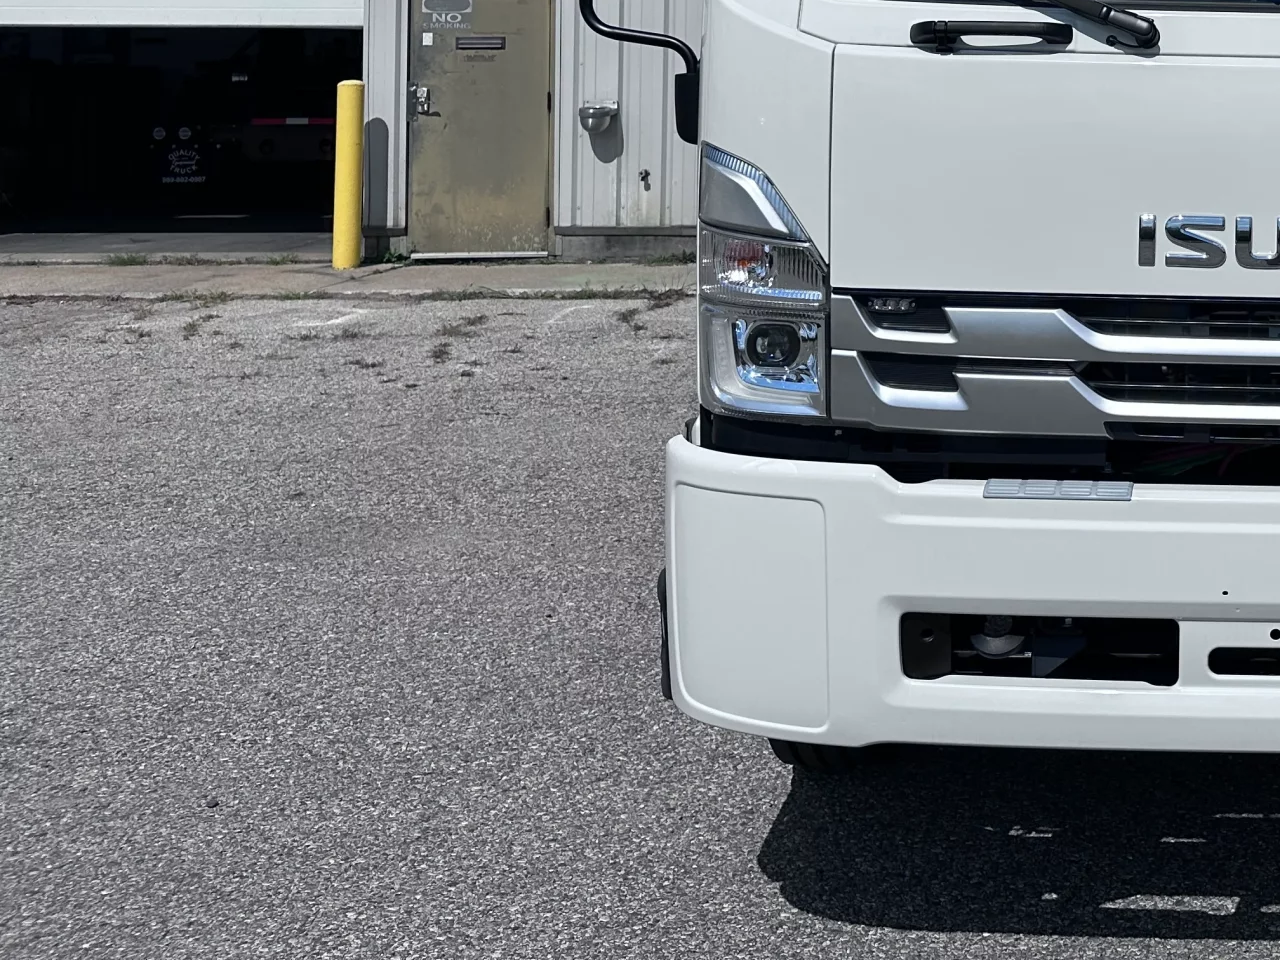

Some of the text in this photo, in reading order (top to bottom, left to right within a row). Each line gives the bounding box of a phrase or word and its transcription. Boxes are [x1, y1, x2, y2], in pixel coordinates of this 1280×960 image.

[432, 13, 462, 22] NO
[168, 149, 201, 161] QUALITY
[170, 164, 198, 174] TRUCK
